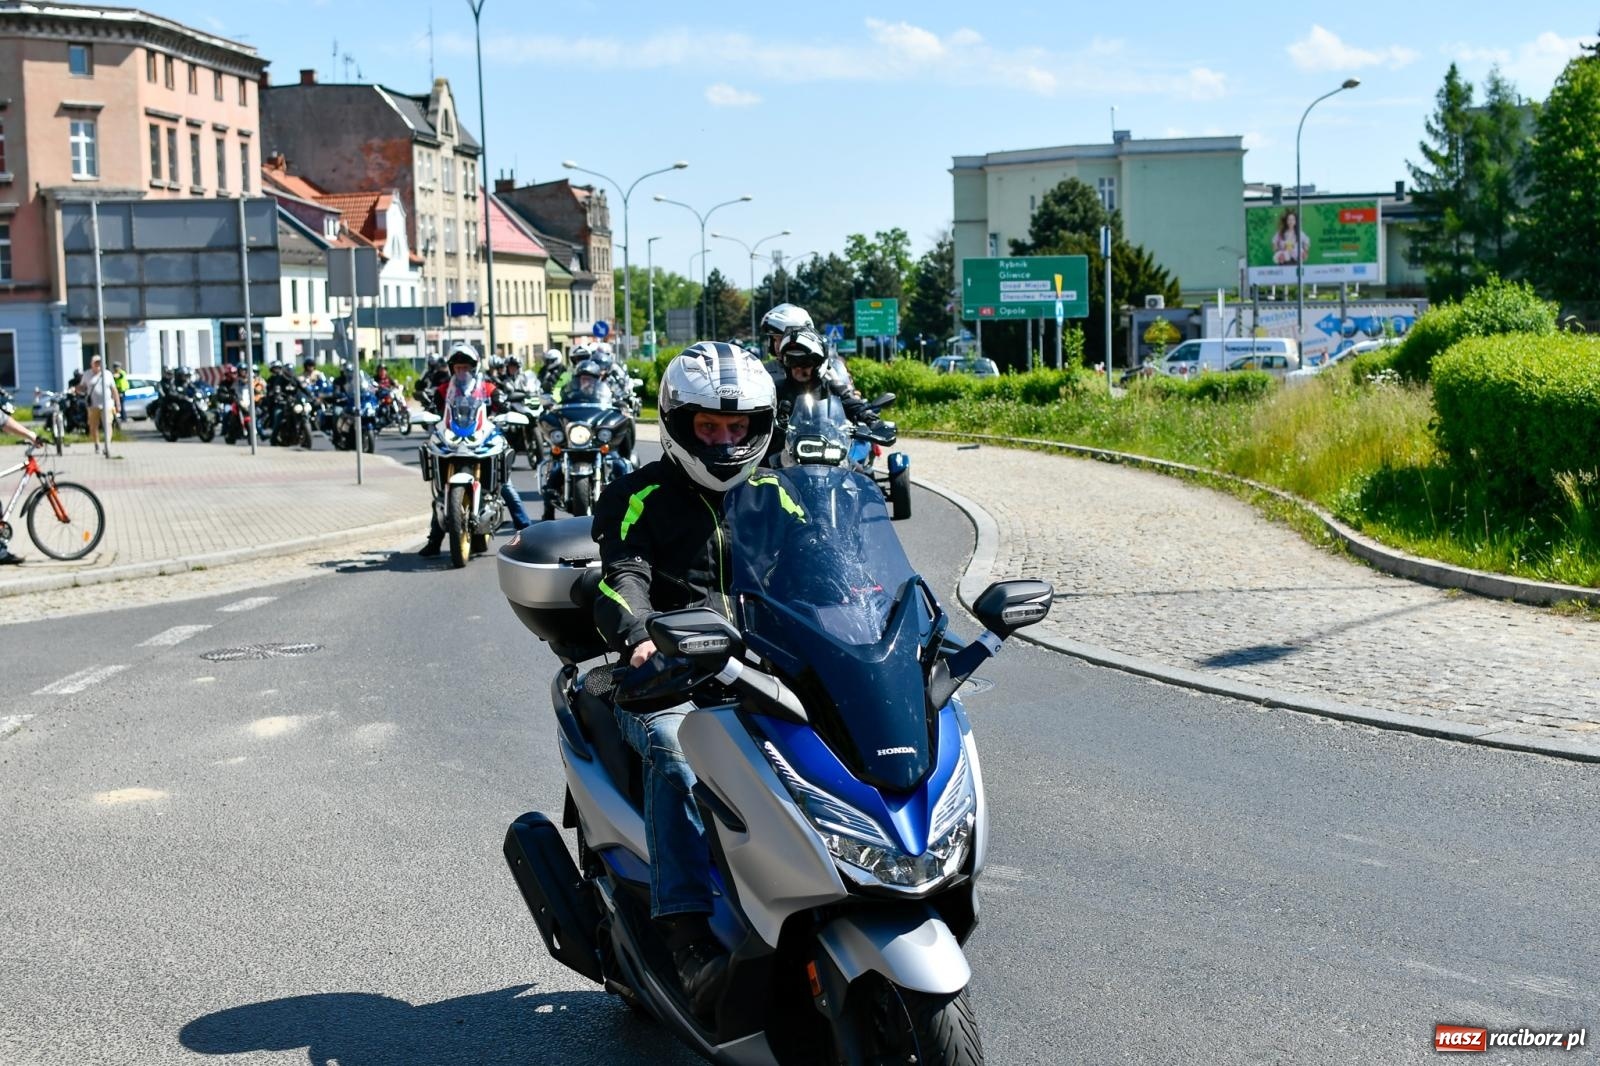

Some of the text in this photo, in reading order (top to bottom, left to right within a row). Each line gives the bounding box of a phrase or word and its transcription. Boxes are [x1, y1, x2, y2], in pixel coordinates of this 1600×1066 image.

[999, 260, 1028, 269] Rybnik
[999, 271, 1031, 279] Gliwice
[1000, 307, 1026, 315] Opole
[877, 746, 917, 757] HONDA
